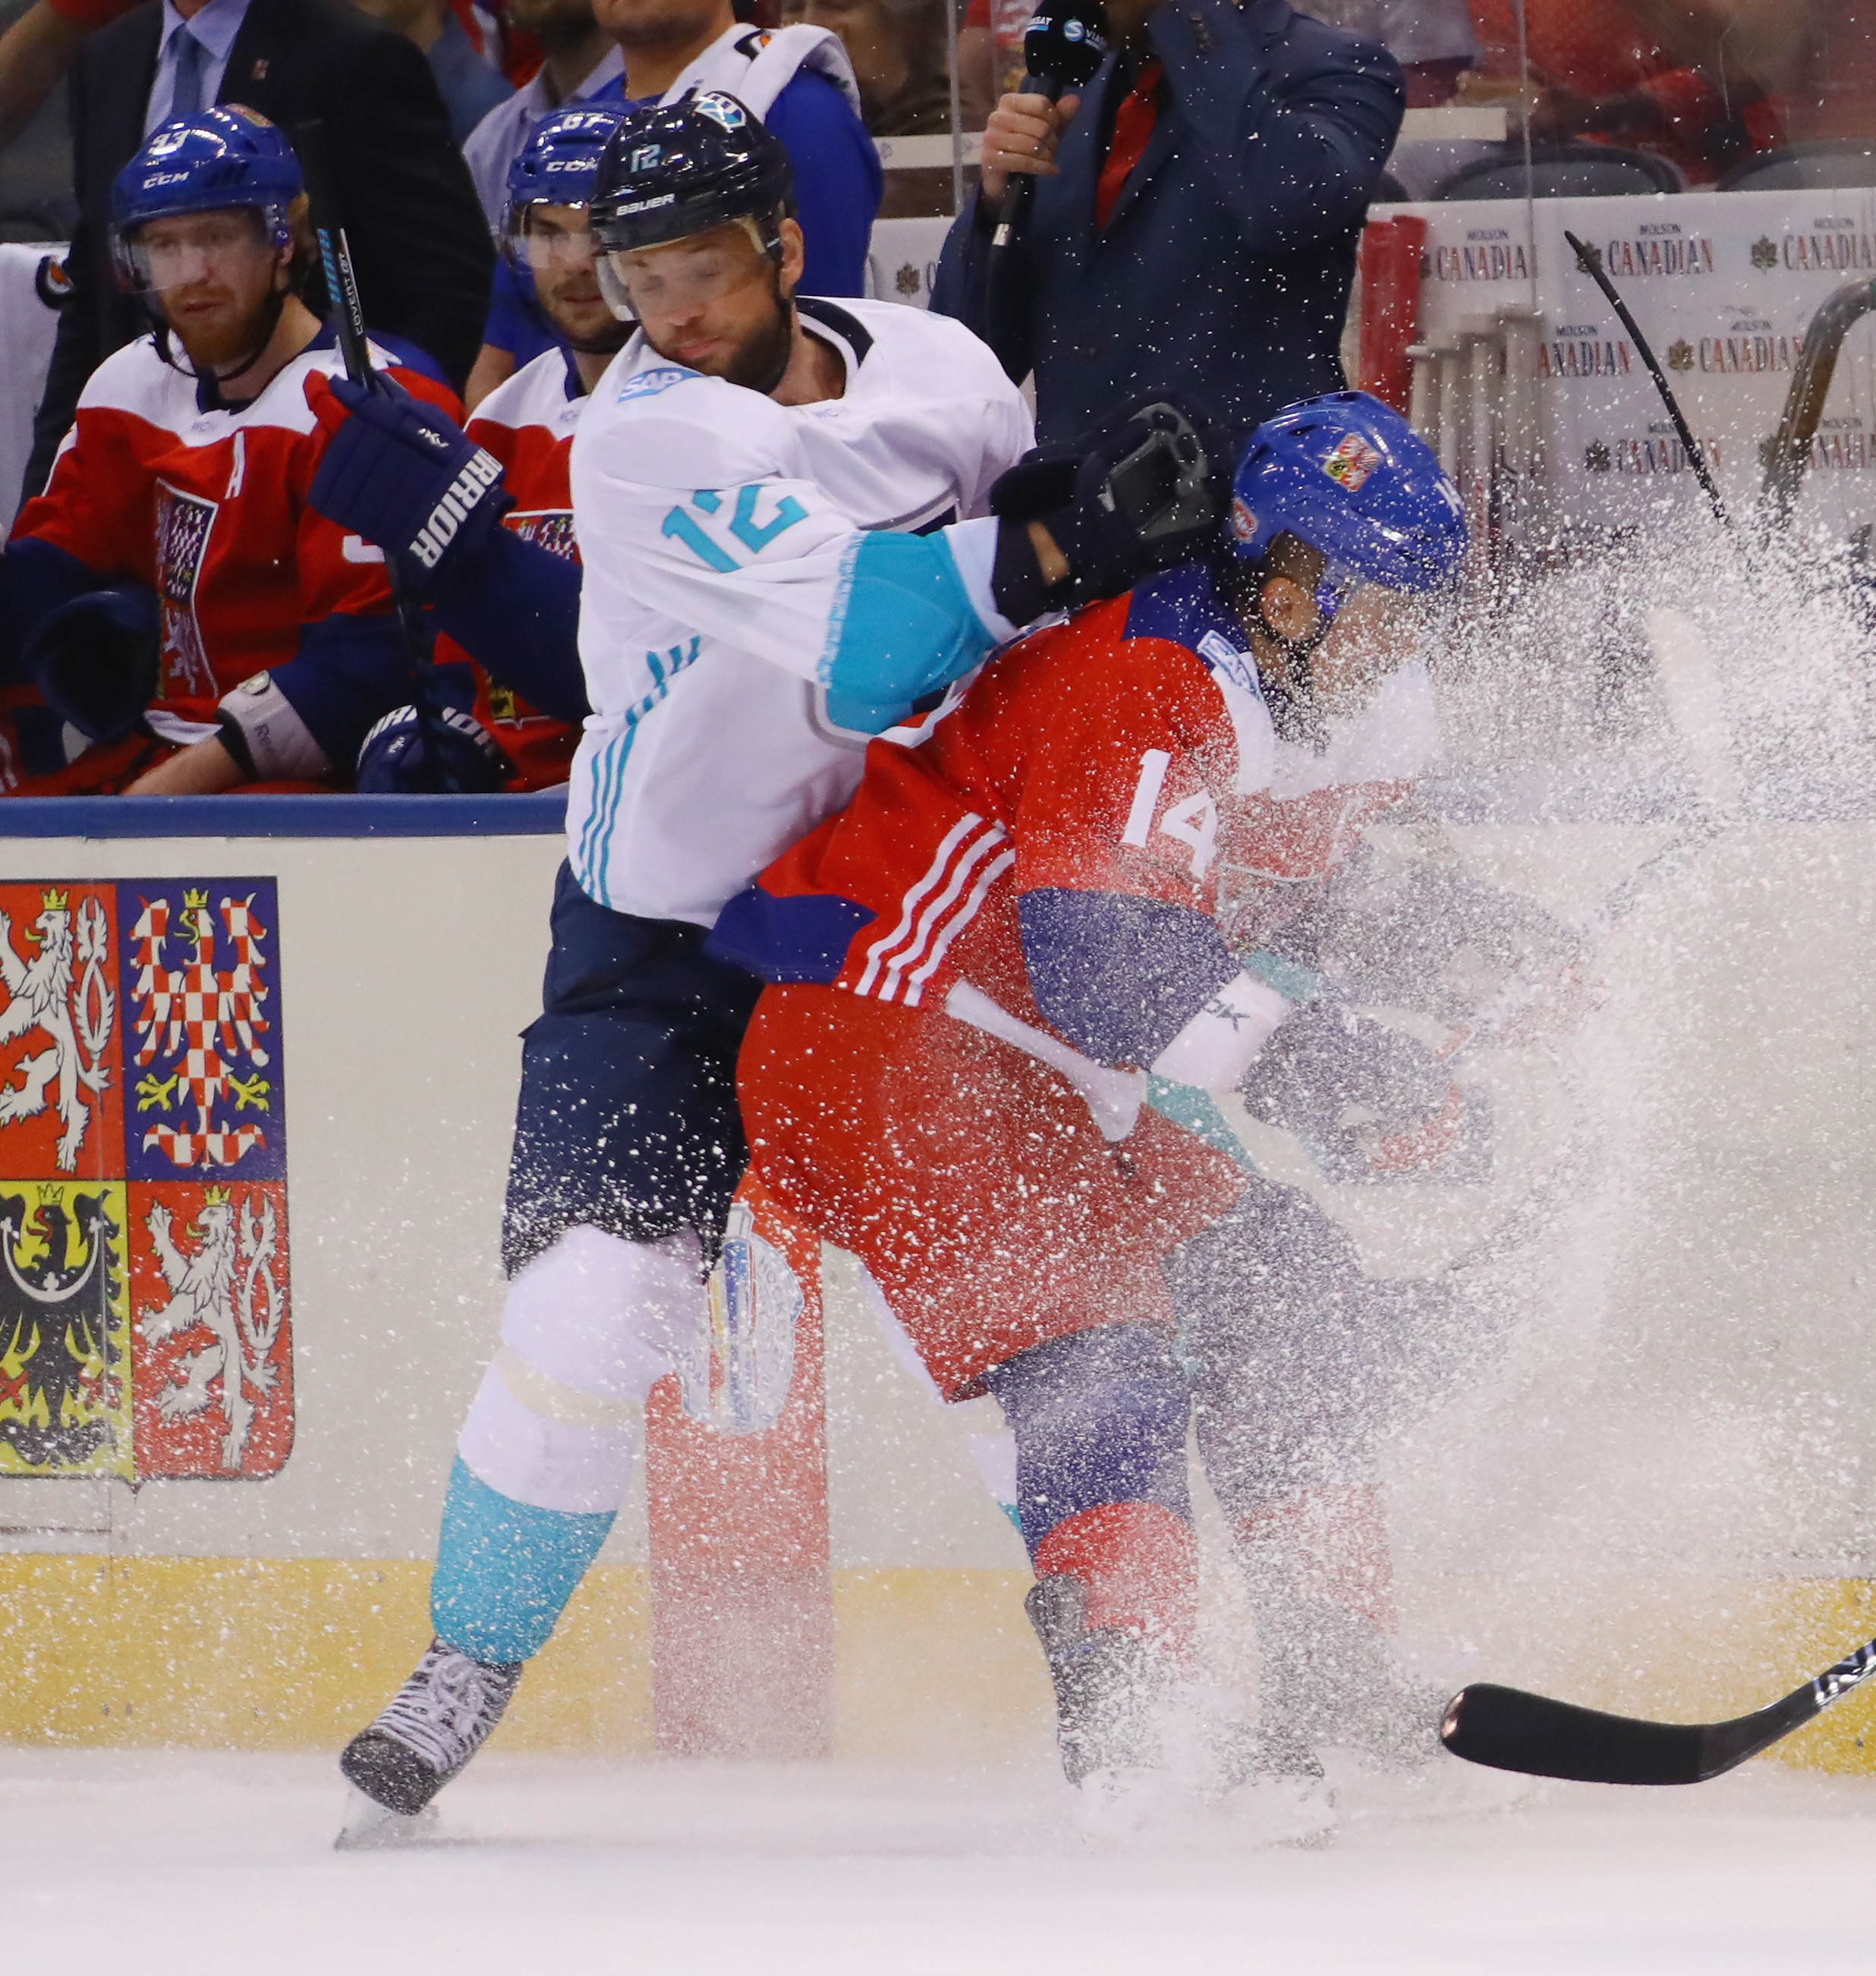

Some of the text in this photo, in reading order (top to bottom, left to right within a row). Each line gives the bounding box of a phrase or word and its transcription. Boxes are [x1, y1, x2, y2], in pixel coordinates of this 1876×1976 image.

[629, 144, 663, 174] 12
[142, 171, 190, 190] CCM
[615, 194, 676, 216] BAUER
[1467, 228, 1509, 241] MOLSON
[1639, 223, 1681, 235] MOLSON
[1607, 238, 1714, 276] CANADIAN
[1783, 234, 1876, 270] CANADIA
[1557, 325, 1598, 336] MOLSON
[1537, 341, 1630, 378] ANADIAN
[618, 371, 682, 398] SAP
[662, 484, 810, 574] 12
[1119, 748, 1220, 883] 14
